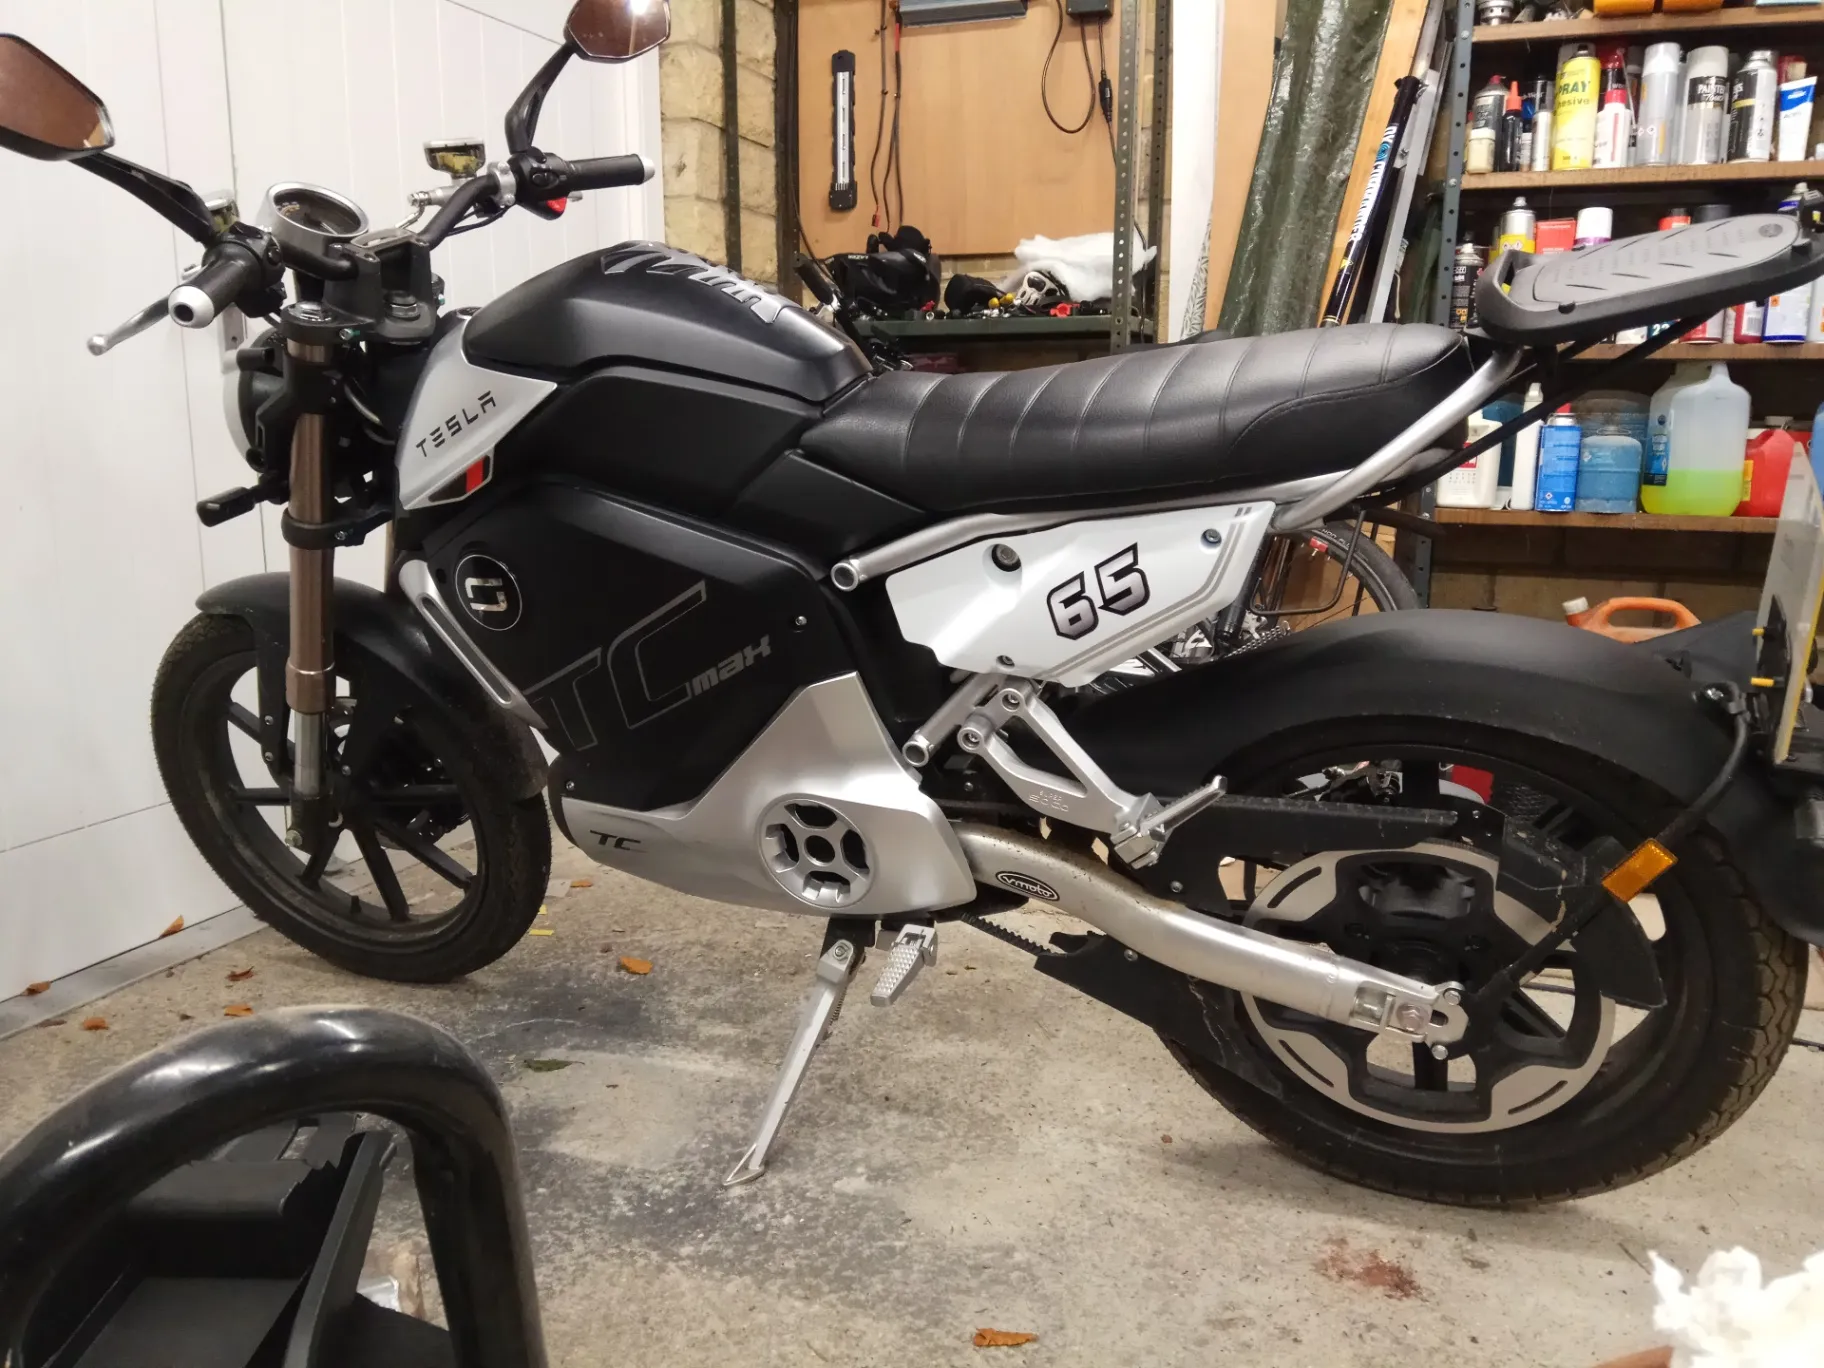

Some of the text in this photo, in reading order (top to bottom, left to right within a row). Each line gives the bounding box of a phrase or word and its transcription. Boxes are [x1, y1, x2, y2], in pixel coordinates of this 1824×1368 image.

[416, 391, 496, 457] TESLA
[1047, 542, 1150, 640] 65
[590, 829, 641, 851] TC
